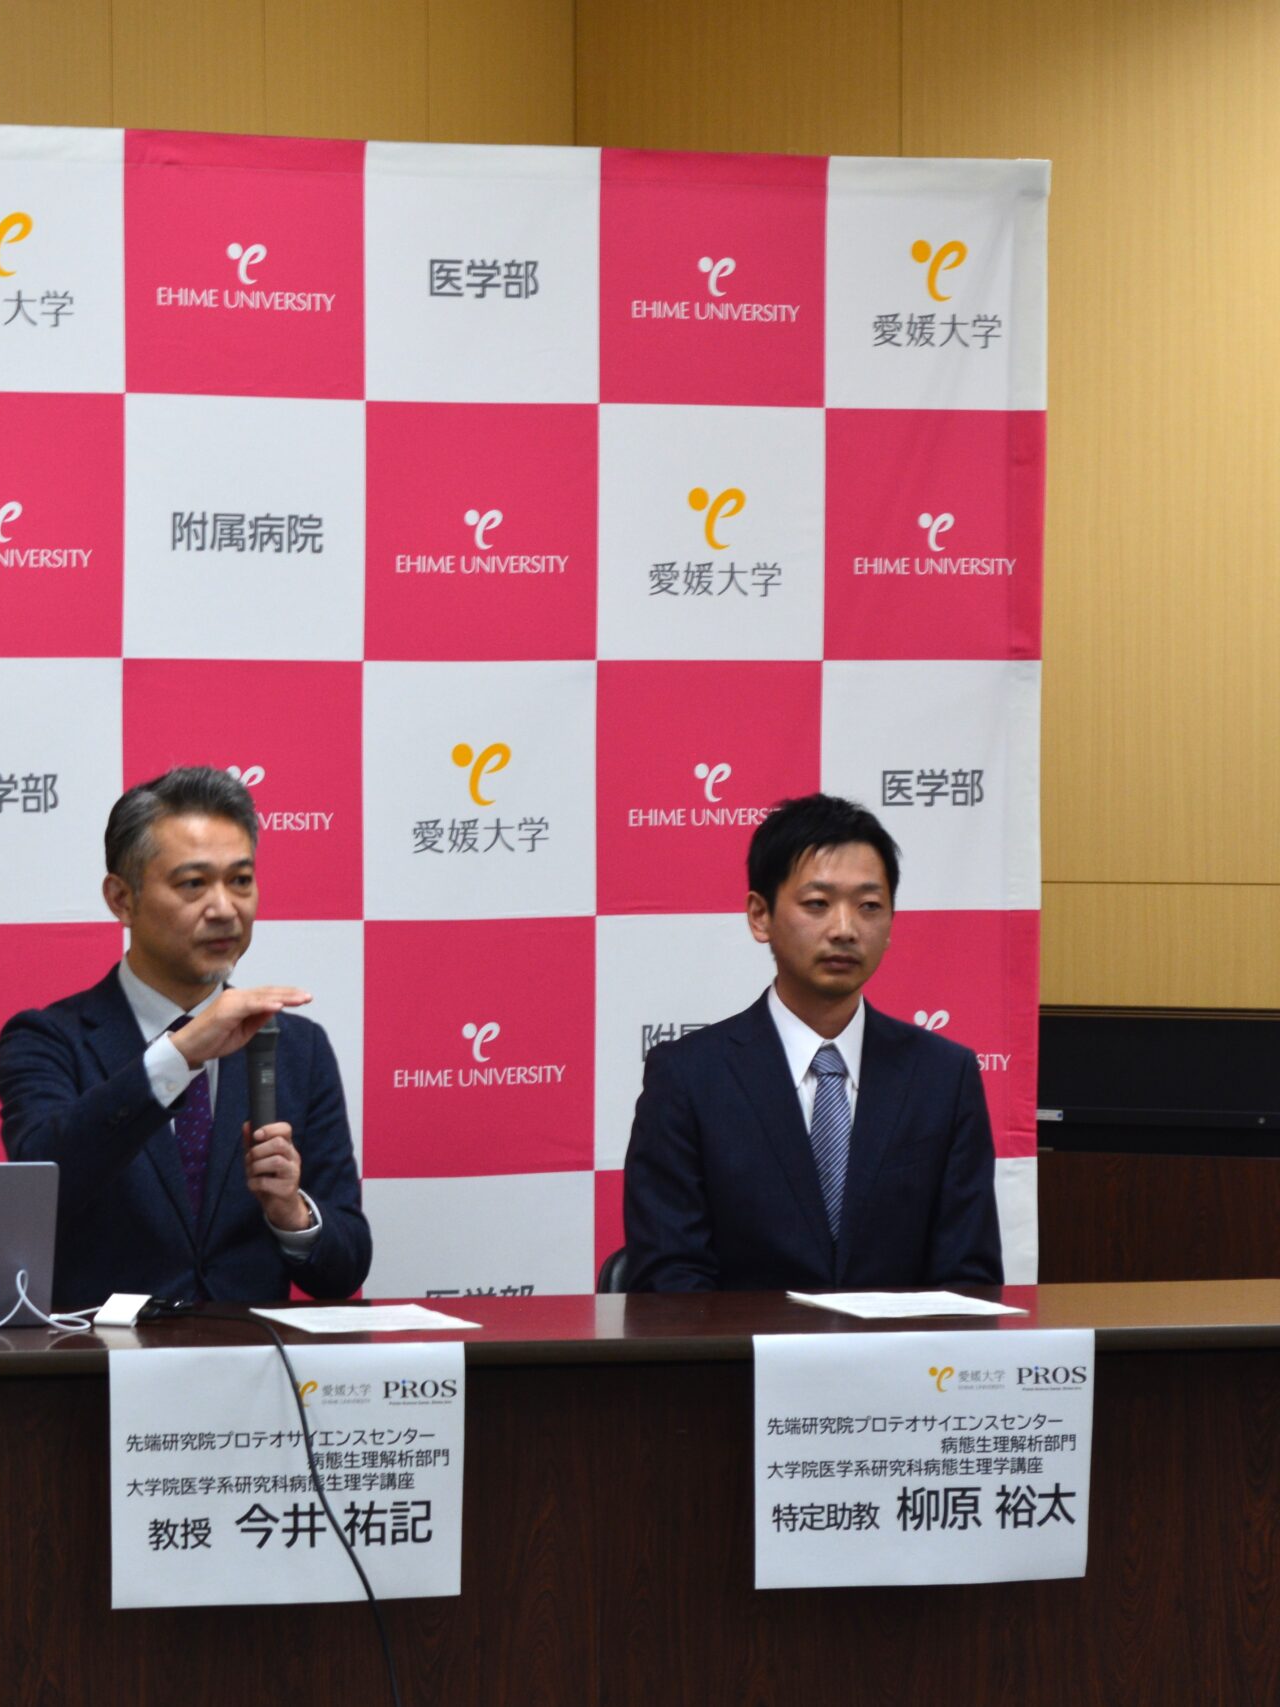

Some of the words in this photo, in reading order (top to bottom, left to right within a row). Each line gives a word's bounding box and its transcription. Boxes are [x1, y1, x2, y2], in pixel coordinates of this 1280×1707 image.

[430, 259, 539, 299] 医学部
[157, 287, 218, 307] EHIME
[224, 290, 335, 312] UNIVERSITY
[632, 300, 690, 319] EHIME
[695, 302, 800, 322] UNIVERSITY
[873, 313, 1001, 349] 愛媛大学
[172, 512, 323, 553] 附属病院
[396, 555, 455, 573] EHIME
[460, 555, 568, 574] UNIVERSITY
[854, 557, 910, 575] EHIME
[915, 558, 1016, 575] UNIVERSITY
[649, 562, 781, 597] 愛媛大学
[882, 769, 984, 807] 医学部
[258, 811, 335, 831] VERSITY
[629, 809, 686, 826] EHIME
[690, 807, 782, 826] UNIVERS
[413, 817, 549, 853] 愛媛大学
[394, 1069, 452, 1088] EHIME
[458, 1065, 566, 1087] UNIVERSITY
[767, 1414, 1063, 1435] 先端研究院プロテオサイエンスセンター
[941, 1434, 1076, 1454] 病態生理解析部門
[767, 1458, 1043, 1480] 大学院医学系研究科病態生理学講座
[772, 1502, 880, 1532] 特定助教
[897, 1487, 982, 1531] 柳原
[995, 1483, 1076, 1529] 裕太
[149, 1518, 211, 1551] 教授
[233, 1502, 327, 1549] 今井
[344, 1500, 433, 1547] 祐記
